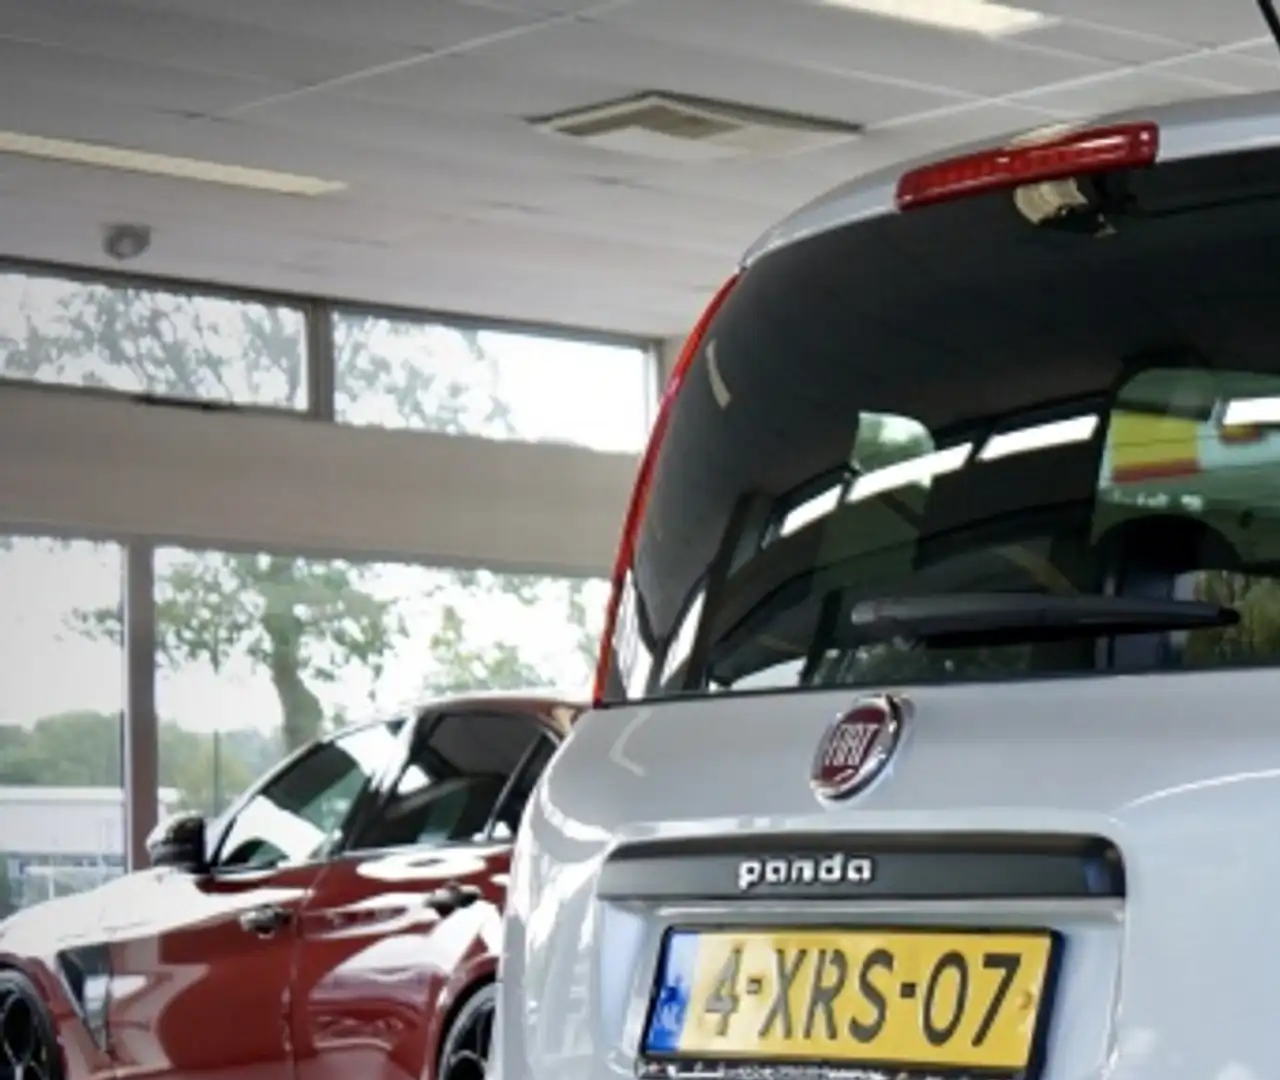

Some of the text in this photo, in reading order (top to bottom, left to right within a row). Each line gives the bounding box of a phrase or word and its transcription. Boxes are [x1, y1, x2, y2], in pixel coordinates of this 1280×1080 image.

[824, 721, 880, 767] FIAT
[738, 852, 873, 891] panda
[704, 942, 1023, 1049] 4-XRS-07
